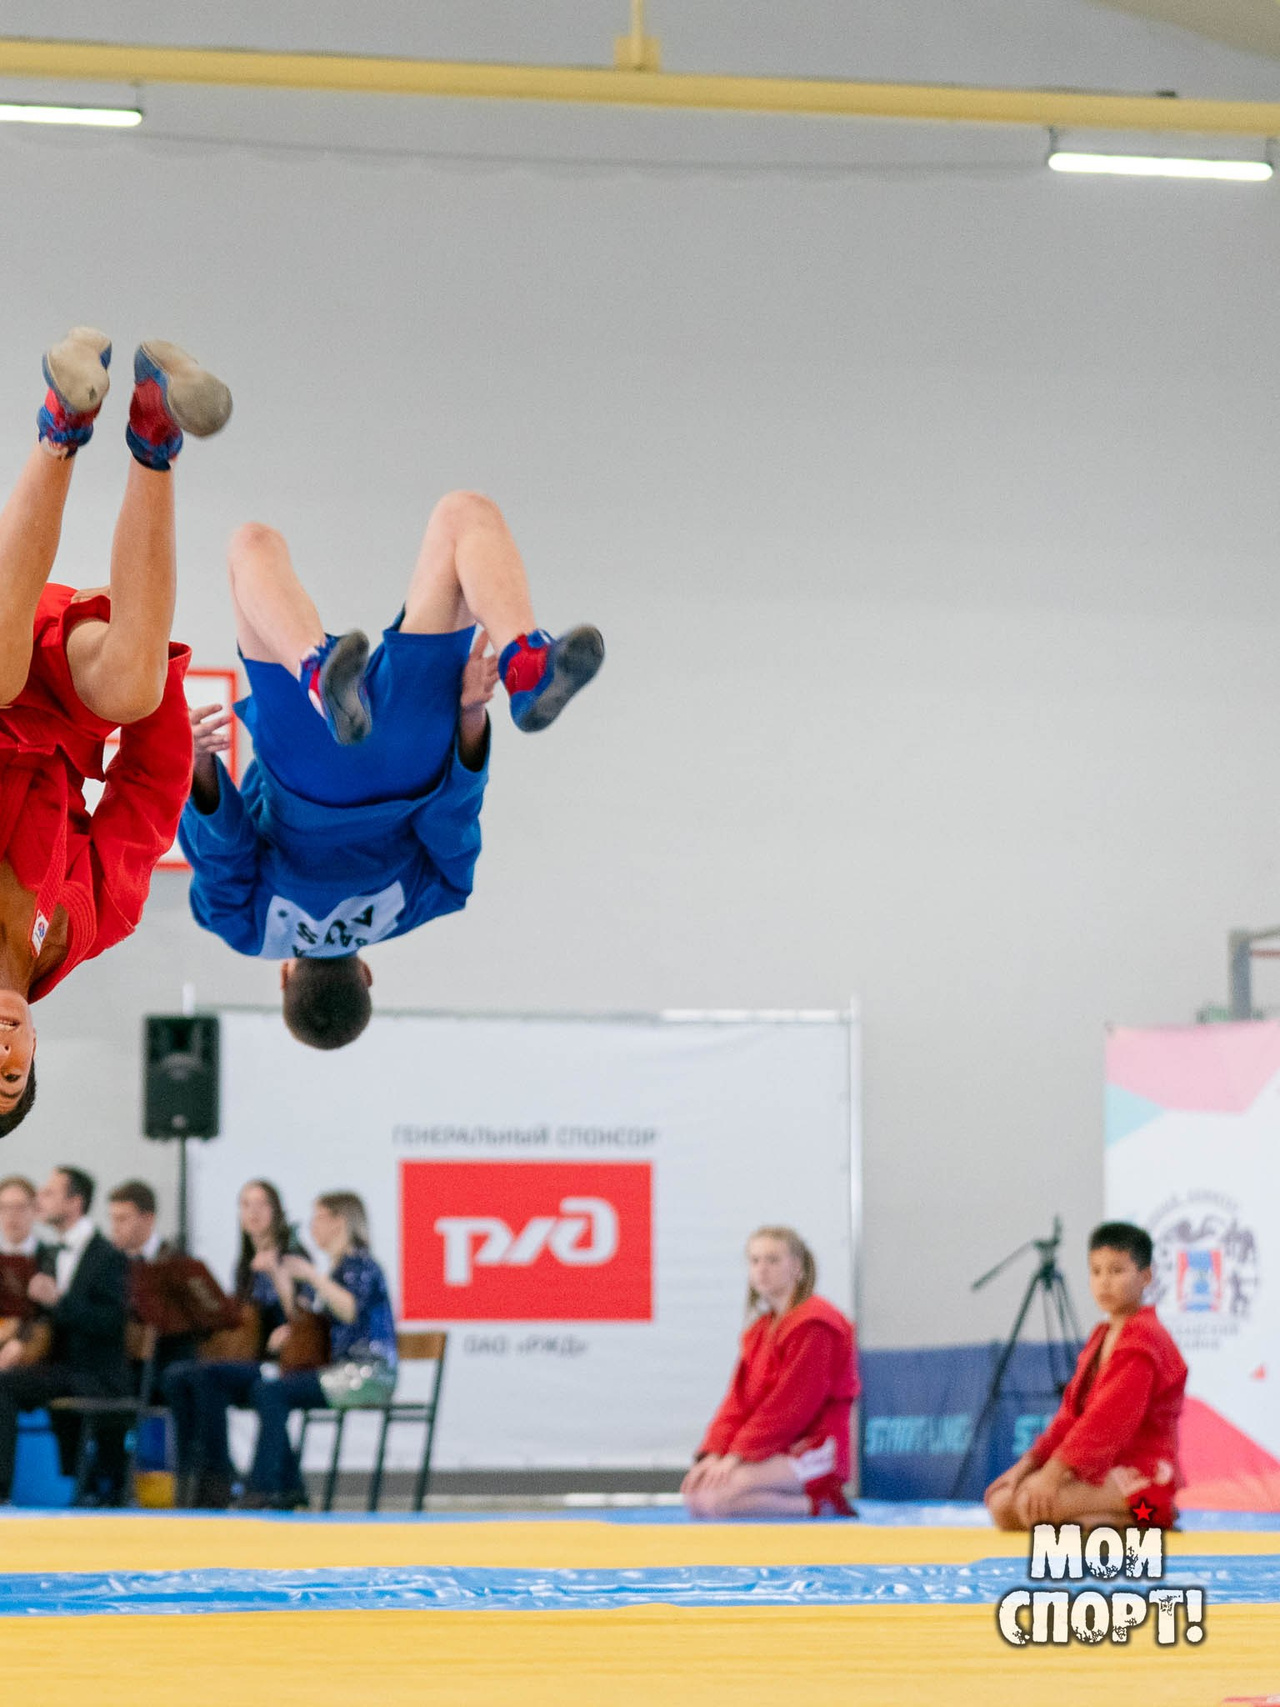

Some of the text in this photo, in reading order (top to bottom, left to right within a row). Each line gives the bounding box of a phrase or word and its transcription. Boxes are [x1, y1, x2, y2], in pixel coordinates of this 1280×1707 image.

[392, 1125, 658, 1146] ГЕНЕРАЛЬНЫЙ СПОНСОР
[463, 1334, 506, 1356] ОАО
